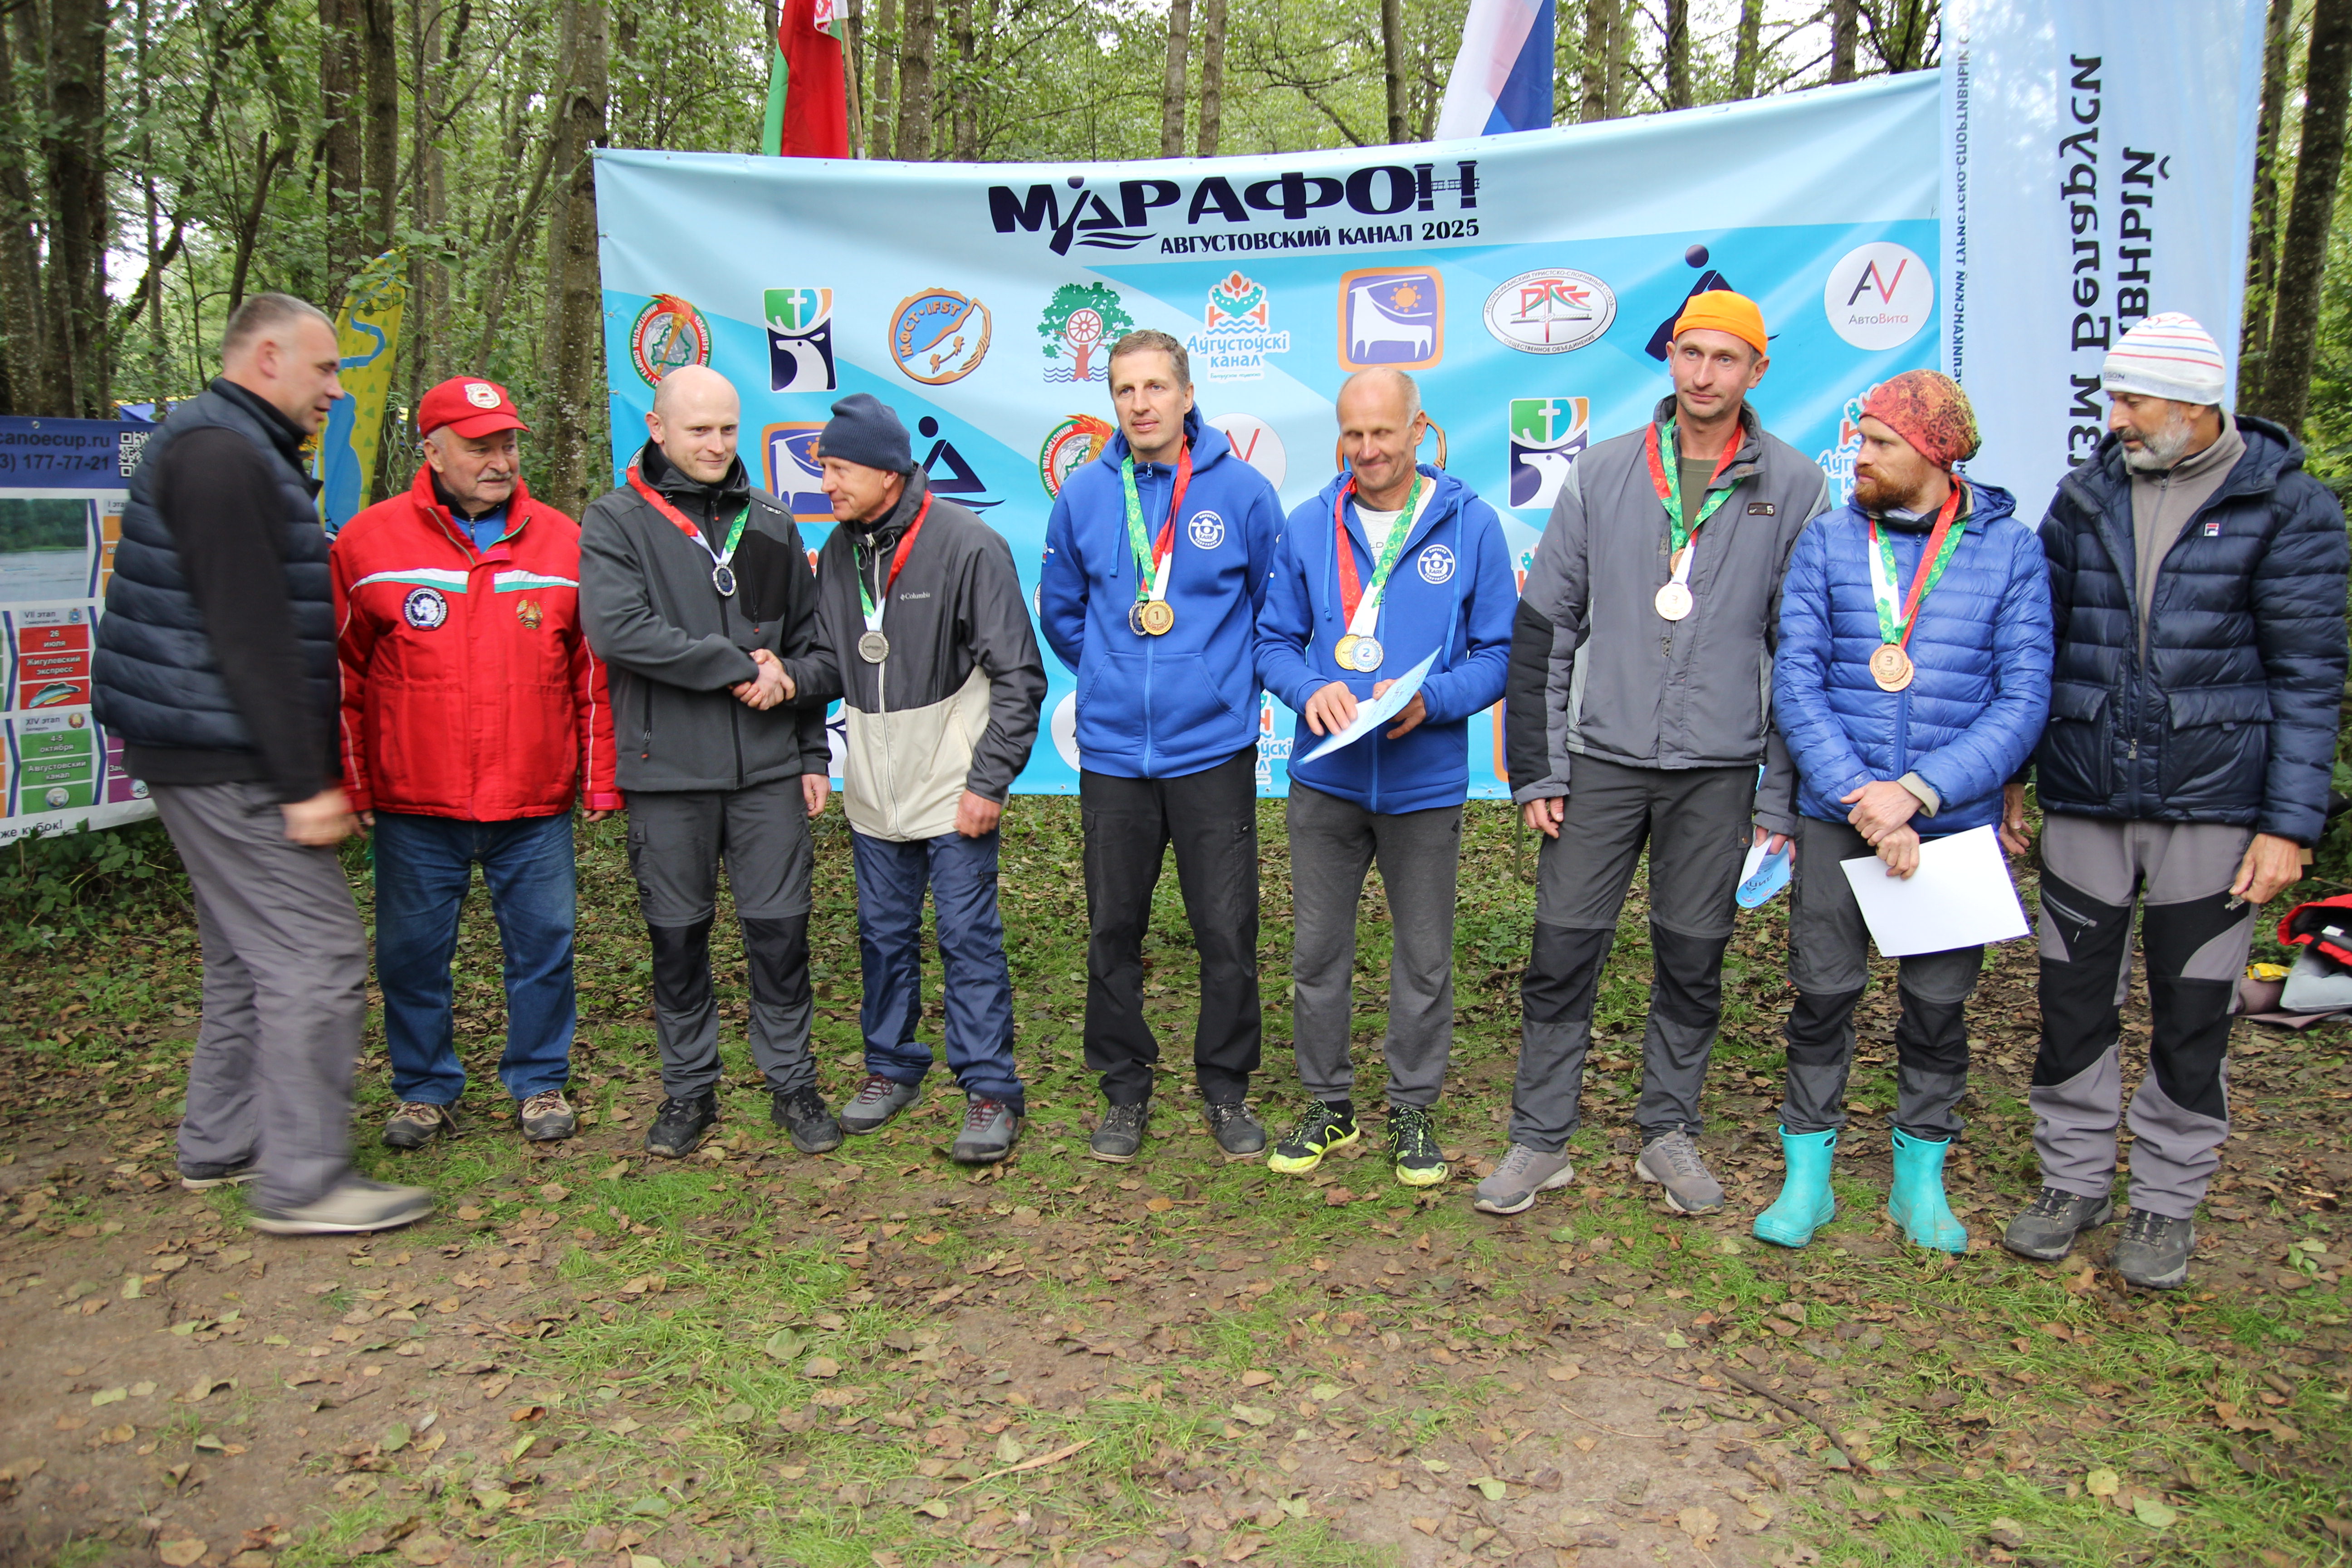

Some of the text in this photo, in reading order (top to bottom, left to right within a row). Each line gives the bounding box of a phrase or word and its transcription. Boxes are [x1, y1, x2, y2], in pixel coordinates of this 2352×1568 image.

[989, 161, 1479, 255] МАРАФОН
[1161, 219, 1479, 254] АВГУСТОВСКИЙ КАНАЛ 2025
[1531, 270, 1604, 289] ТУРИСТСКО-СПОРТИВНЫЙ
[1848, 313, 1908, 325] АвтоВита
[632, 304, 659, 348] МІНІСТЭРСТВА
[694, 315, 709, 351] БЕЛАРУСЬ
[1504, 333, 1596, 353] ОБЩЕСТВЕННОЕ ОБЪЕДИНЕНИЕ
[632, 350, 649, 376] СПОРТУ
[1210, 355, 1261, 368] канал
[1042, 424, 1074, 470] МІНІСТЭРСТВА
[24, 454, 109, 470] 177-77-21
[1766, 505, 1774, 514] 5
[905, 591, 930, 600] Columbia
[1154, 611, 1159, 620] 1
[1363, 648, 1370, 657] 2
[26, 656, 81, 666] Жигулевский
[1884, 655, 1894, 666] 3
[36, 667, 74, 675] экспресс
[39, 744, 74, 754] октября
[28, 760, 87, 773] Августовский
[46, 771, 70, 780] канал
